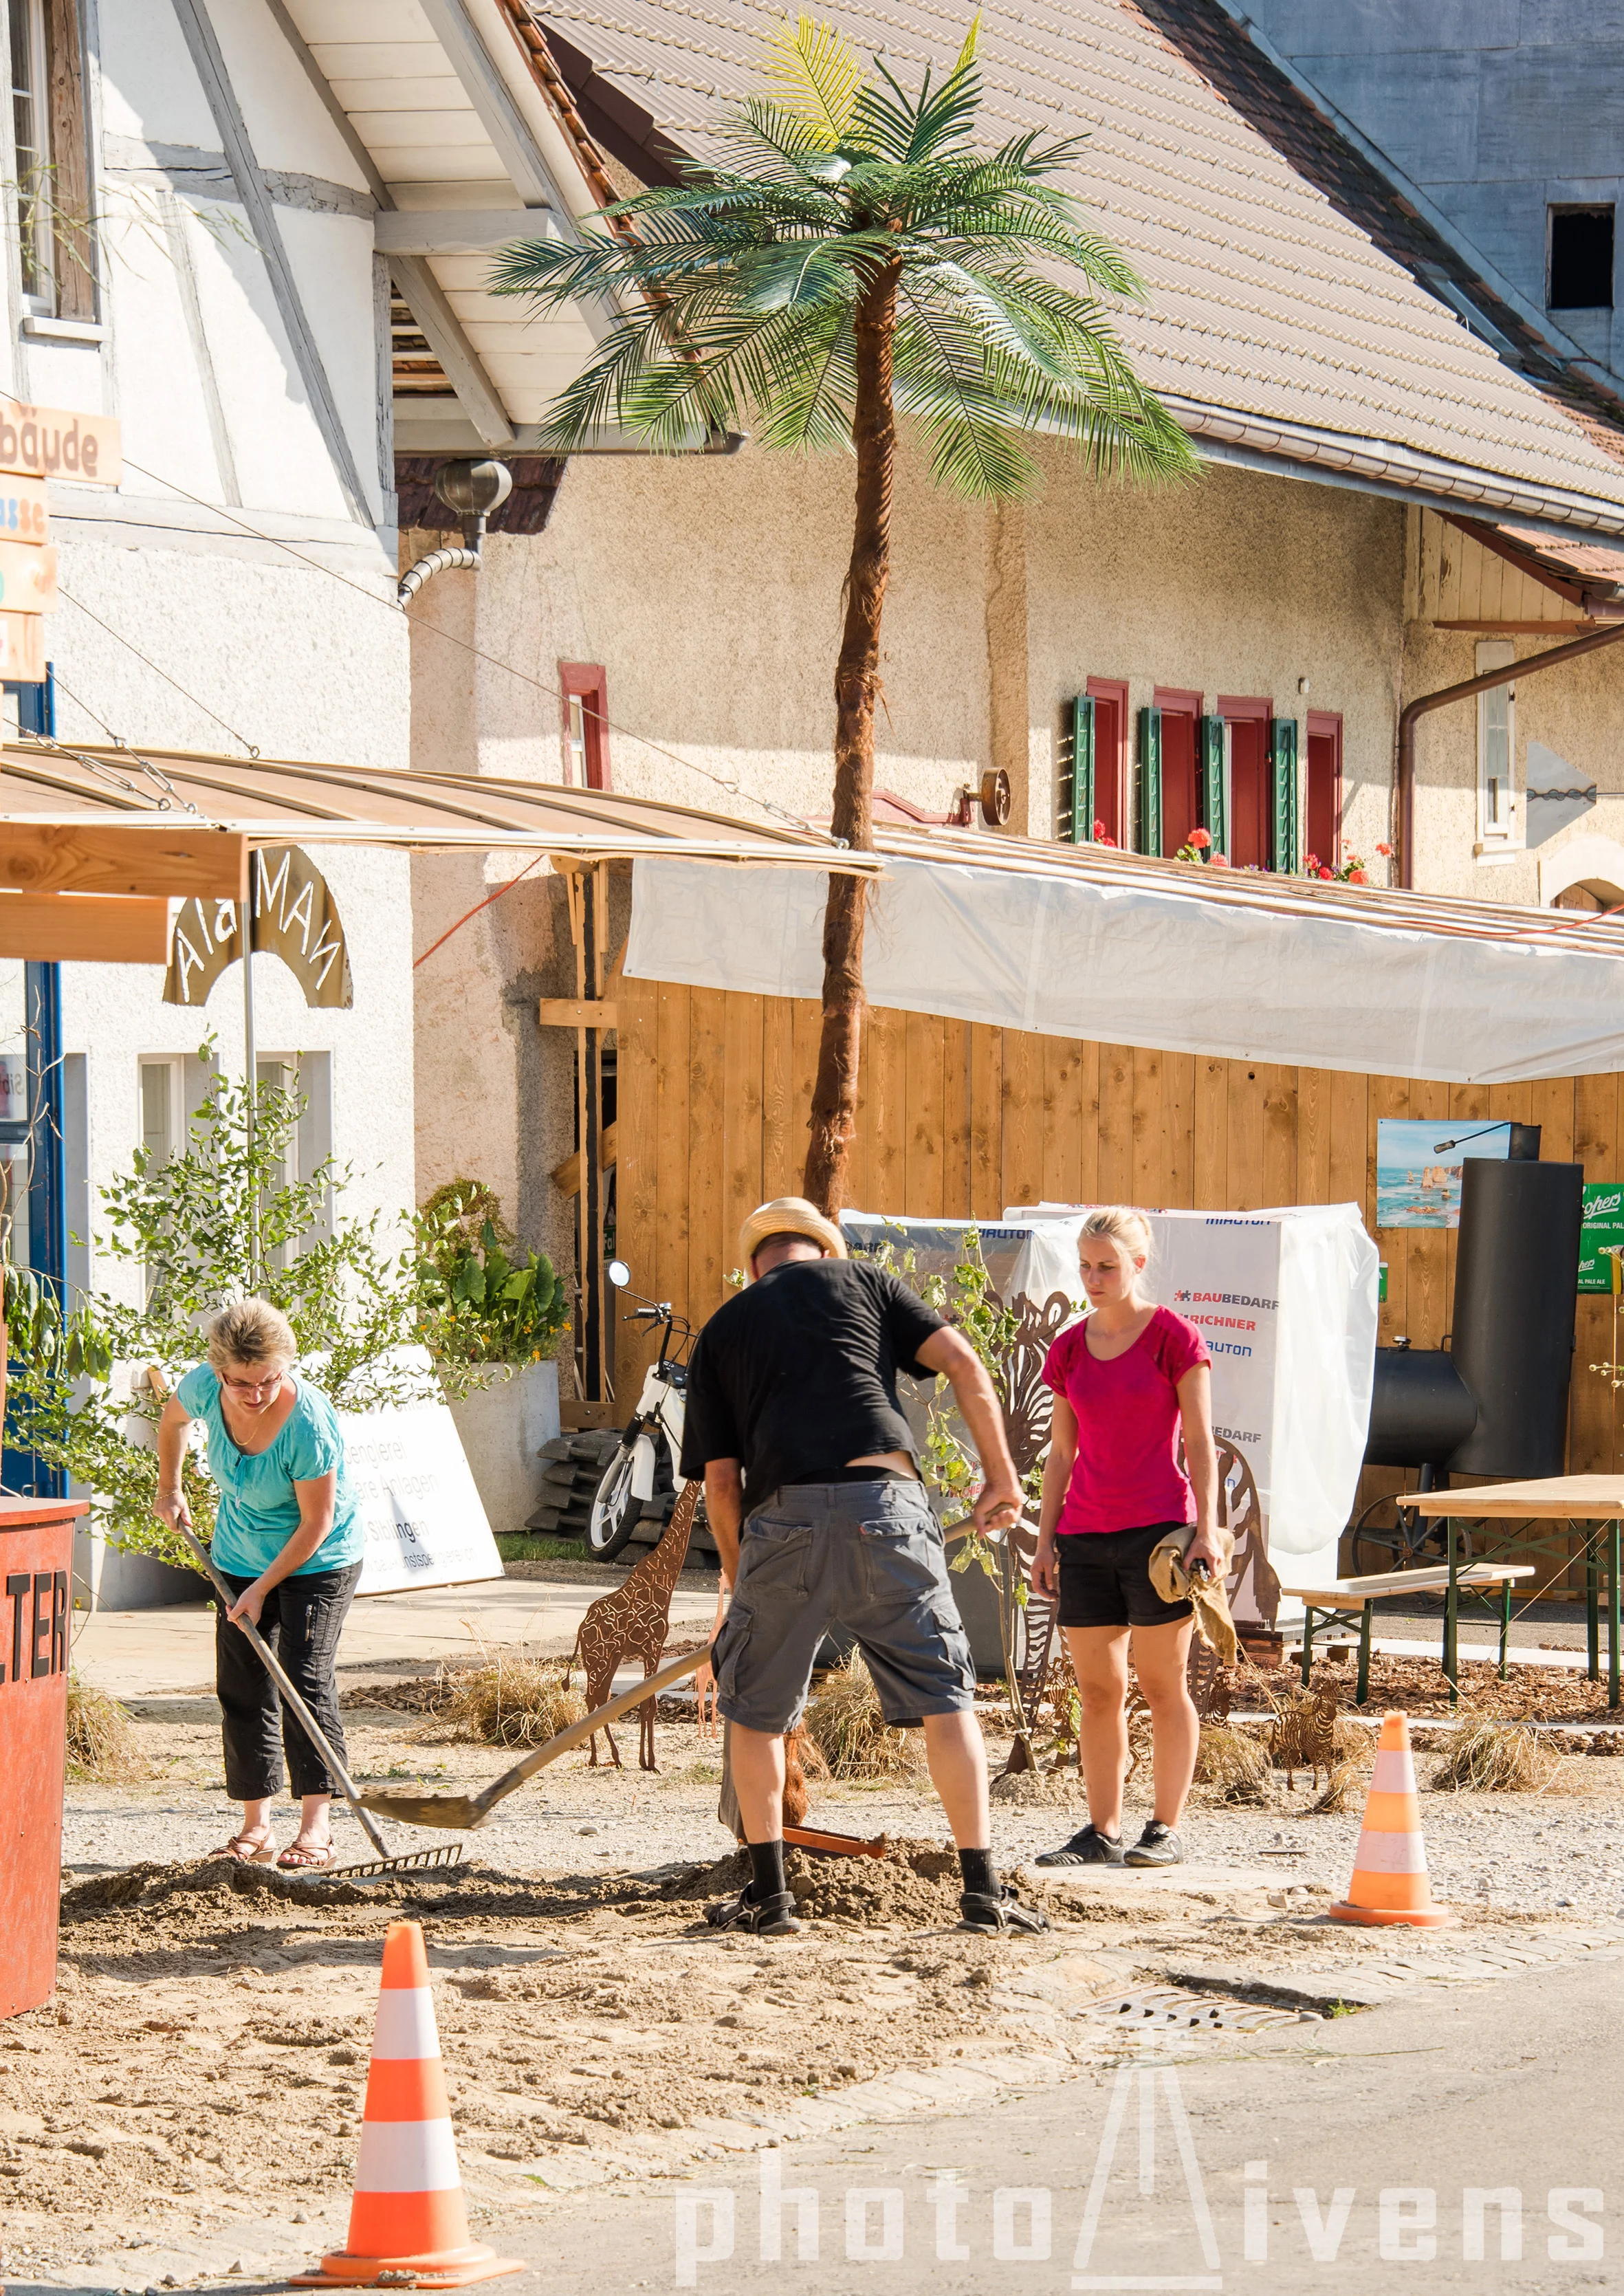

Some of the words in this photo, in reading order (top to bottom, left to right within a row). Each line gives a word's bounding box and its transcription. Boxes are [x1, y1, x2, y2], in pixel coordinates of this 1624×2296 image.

[1582, 1187, 1621, 1219] opers
[1193, 1293, 1280, 1310] BAUBEDARF
[1190, 1315, 1256, 1331] RICHNER
[379, 1472, 440, 1500] Anlagen
[368, 1518, 430, 1544] Siblingen
[0, 1570, 67, 1684] TER
